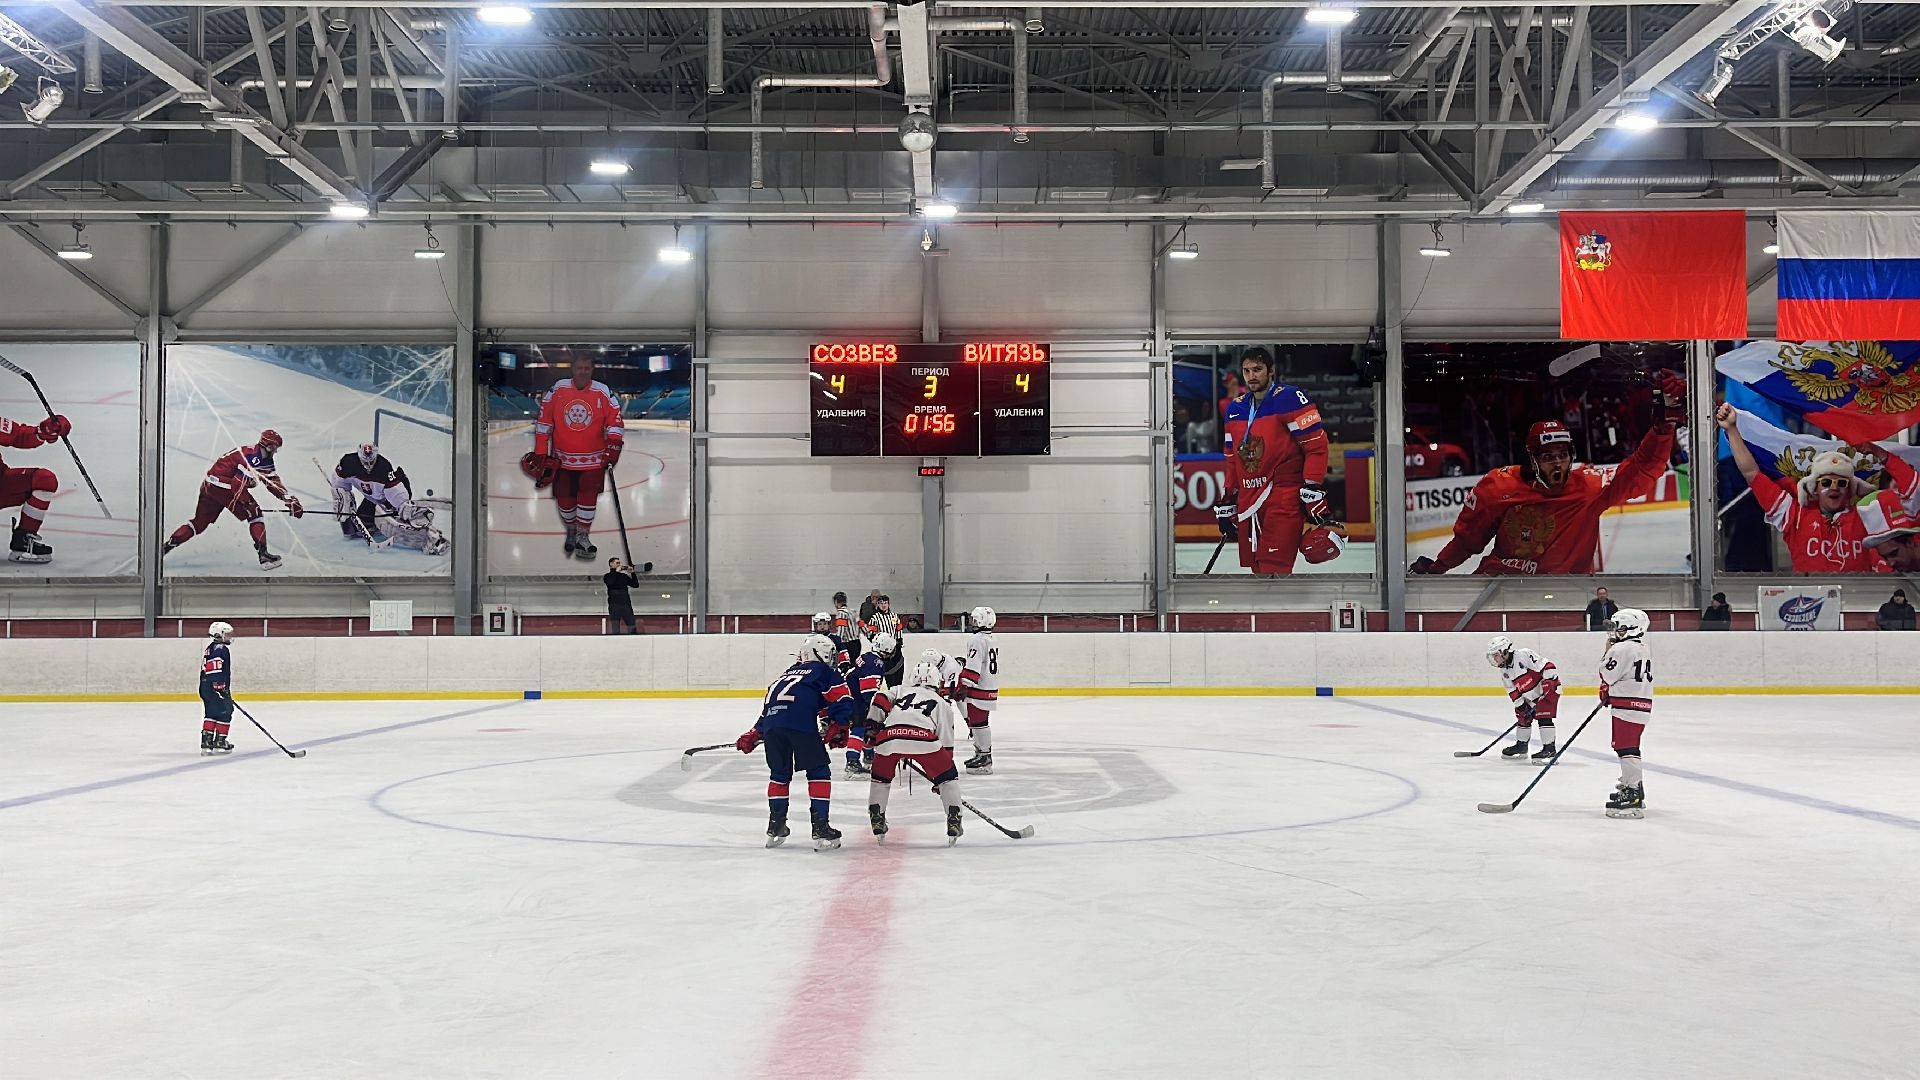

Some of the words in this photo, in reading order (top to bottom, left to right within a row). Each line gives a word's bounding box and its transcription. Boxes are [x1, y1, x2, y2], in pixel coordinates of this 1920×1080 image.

[813, 344, 898, 363] СОЗВЕЗ
[965, 344, 1046, 363] ВИТЯЗЬ
[911, 367, 950, 377] ПЕРИОД
[830, 374, 845, 394] 4
[923, 376, 938, 399] 3
[1015, 373, 1030, 393] 4
[1296, 390, 1309, 405] 8
[816, 409, 867, 418] УДАЛЕНИЯ
[914, 405, 947, 414] ВРЕМЯ
[994, 408, 1044, 417] УДАЛЕНИЯ
[903, 413, 956, 433] 01:56
[1806, 537, 1862, 560] СССР
[894, 692, 938, 718] 44
[887, 728, 930, 737] ПОДОЛЬСК
